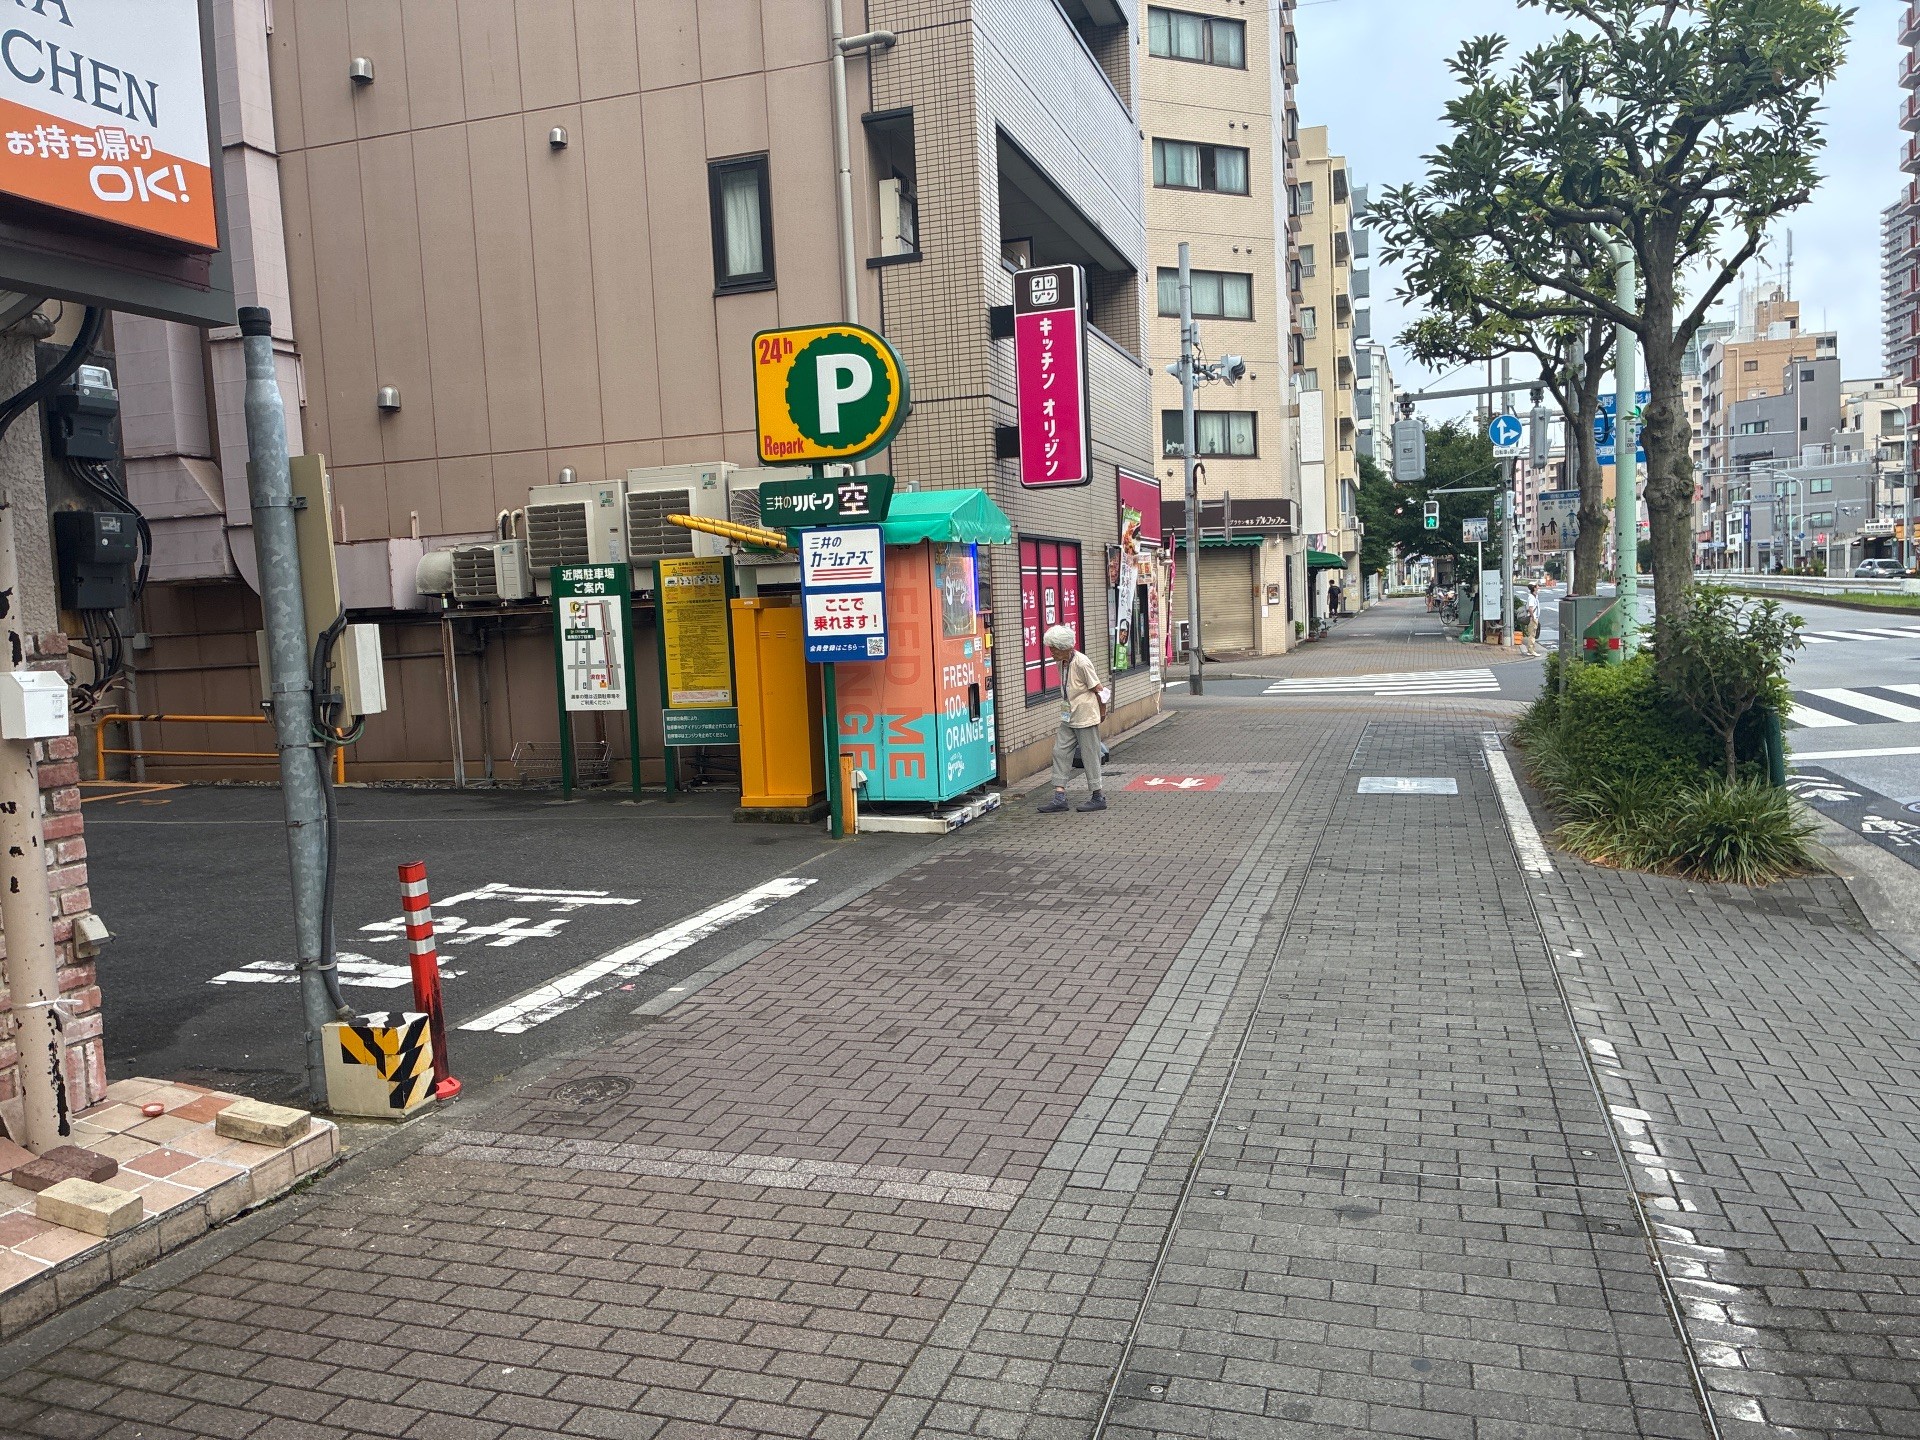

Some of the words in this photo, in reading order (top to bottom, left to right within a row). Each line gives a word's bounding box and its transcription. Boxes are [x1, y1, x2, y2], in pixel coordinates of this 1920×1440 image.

[5, 124, 152, 162] お持ち帰り
[89, 164, 190, 203] OK!
[759, 337, 793, 365] 24h
[1039, 318, 1056, 390] キッチン
[816, 353, 873, 434] P
[764, 435, 804, 457] Repark
[1043, 398, 1060, 476] オリジン
[766, 492, 834, 512] 三井のリパーク
[838, 483, 869, 515] 空
[810, 536, 842, 550] 三井の
[810, 550, 874, 568] カーシェアーズ
[562, 567, 615, 581] 近隣駐車場
[574, 582, 605, 594] ご案内
[825, 597, 864, 612] ここで
[814, 614, 878, 631] 乗れます！
[943, 662, 975, 690] FRESH
[944, 694, 968, 721] 100%
[888, 707, 926, 780] ME
[946, 718, 984, 751] ORANGE
